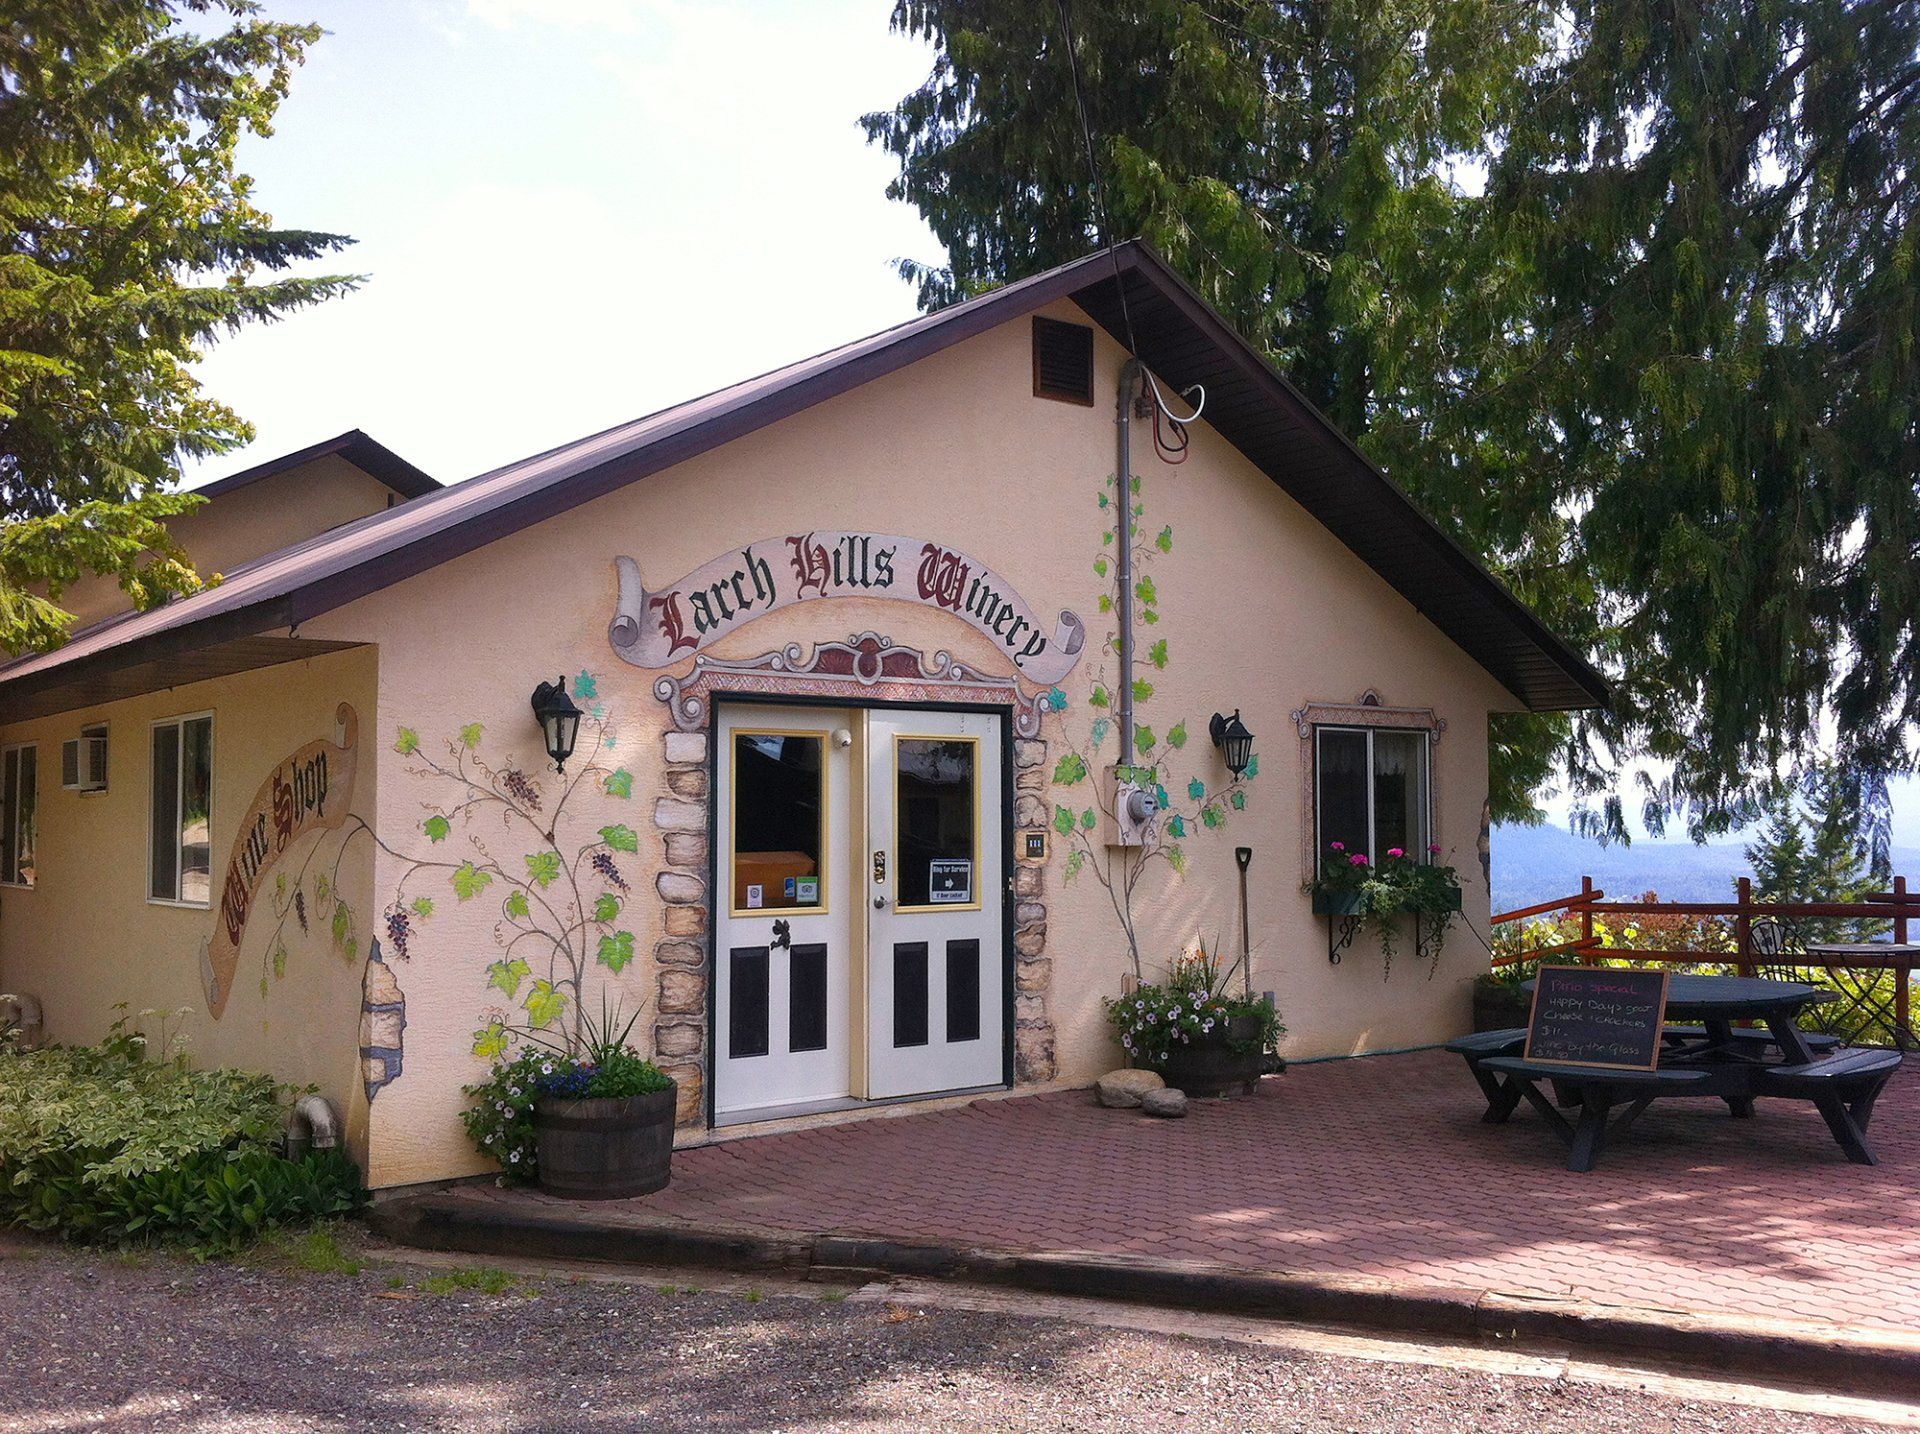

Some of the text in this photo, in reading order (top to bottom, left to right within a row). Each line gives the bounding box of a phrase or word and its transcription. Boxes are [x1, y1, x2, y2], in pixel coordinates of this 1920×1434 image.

[649, 531, 1047, 668] Larch Hills Winery
[221, 750, 328, 947] Wine Shop
[1588, 999, 1622, 1014] Days
